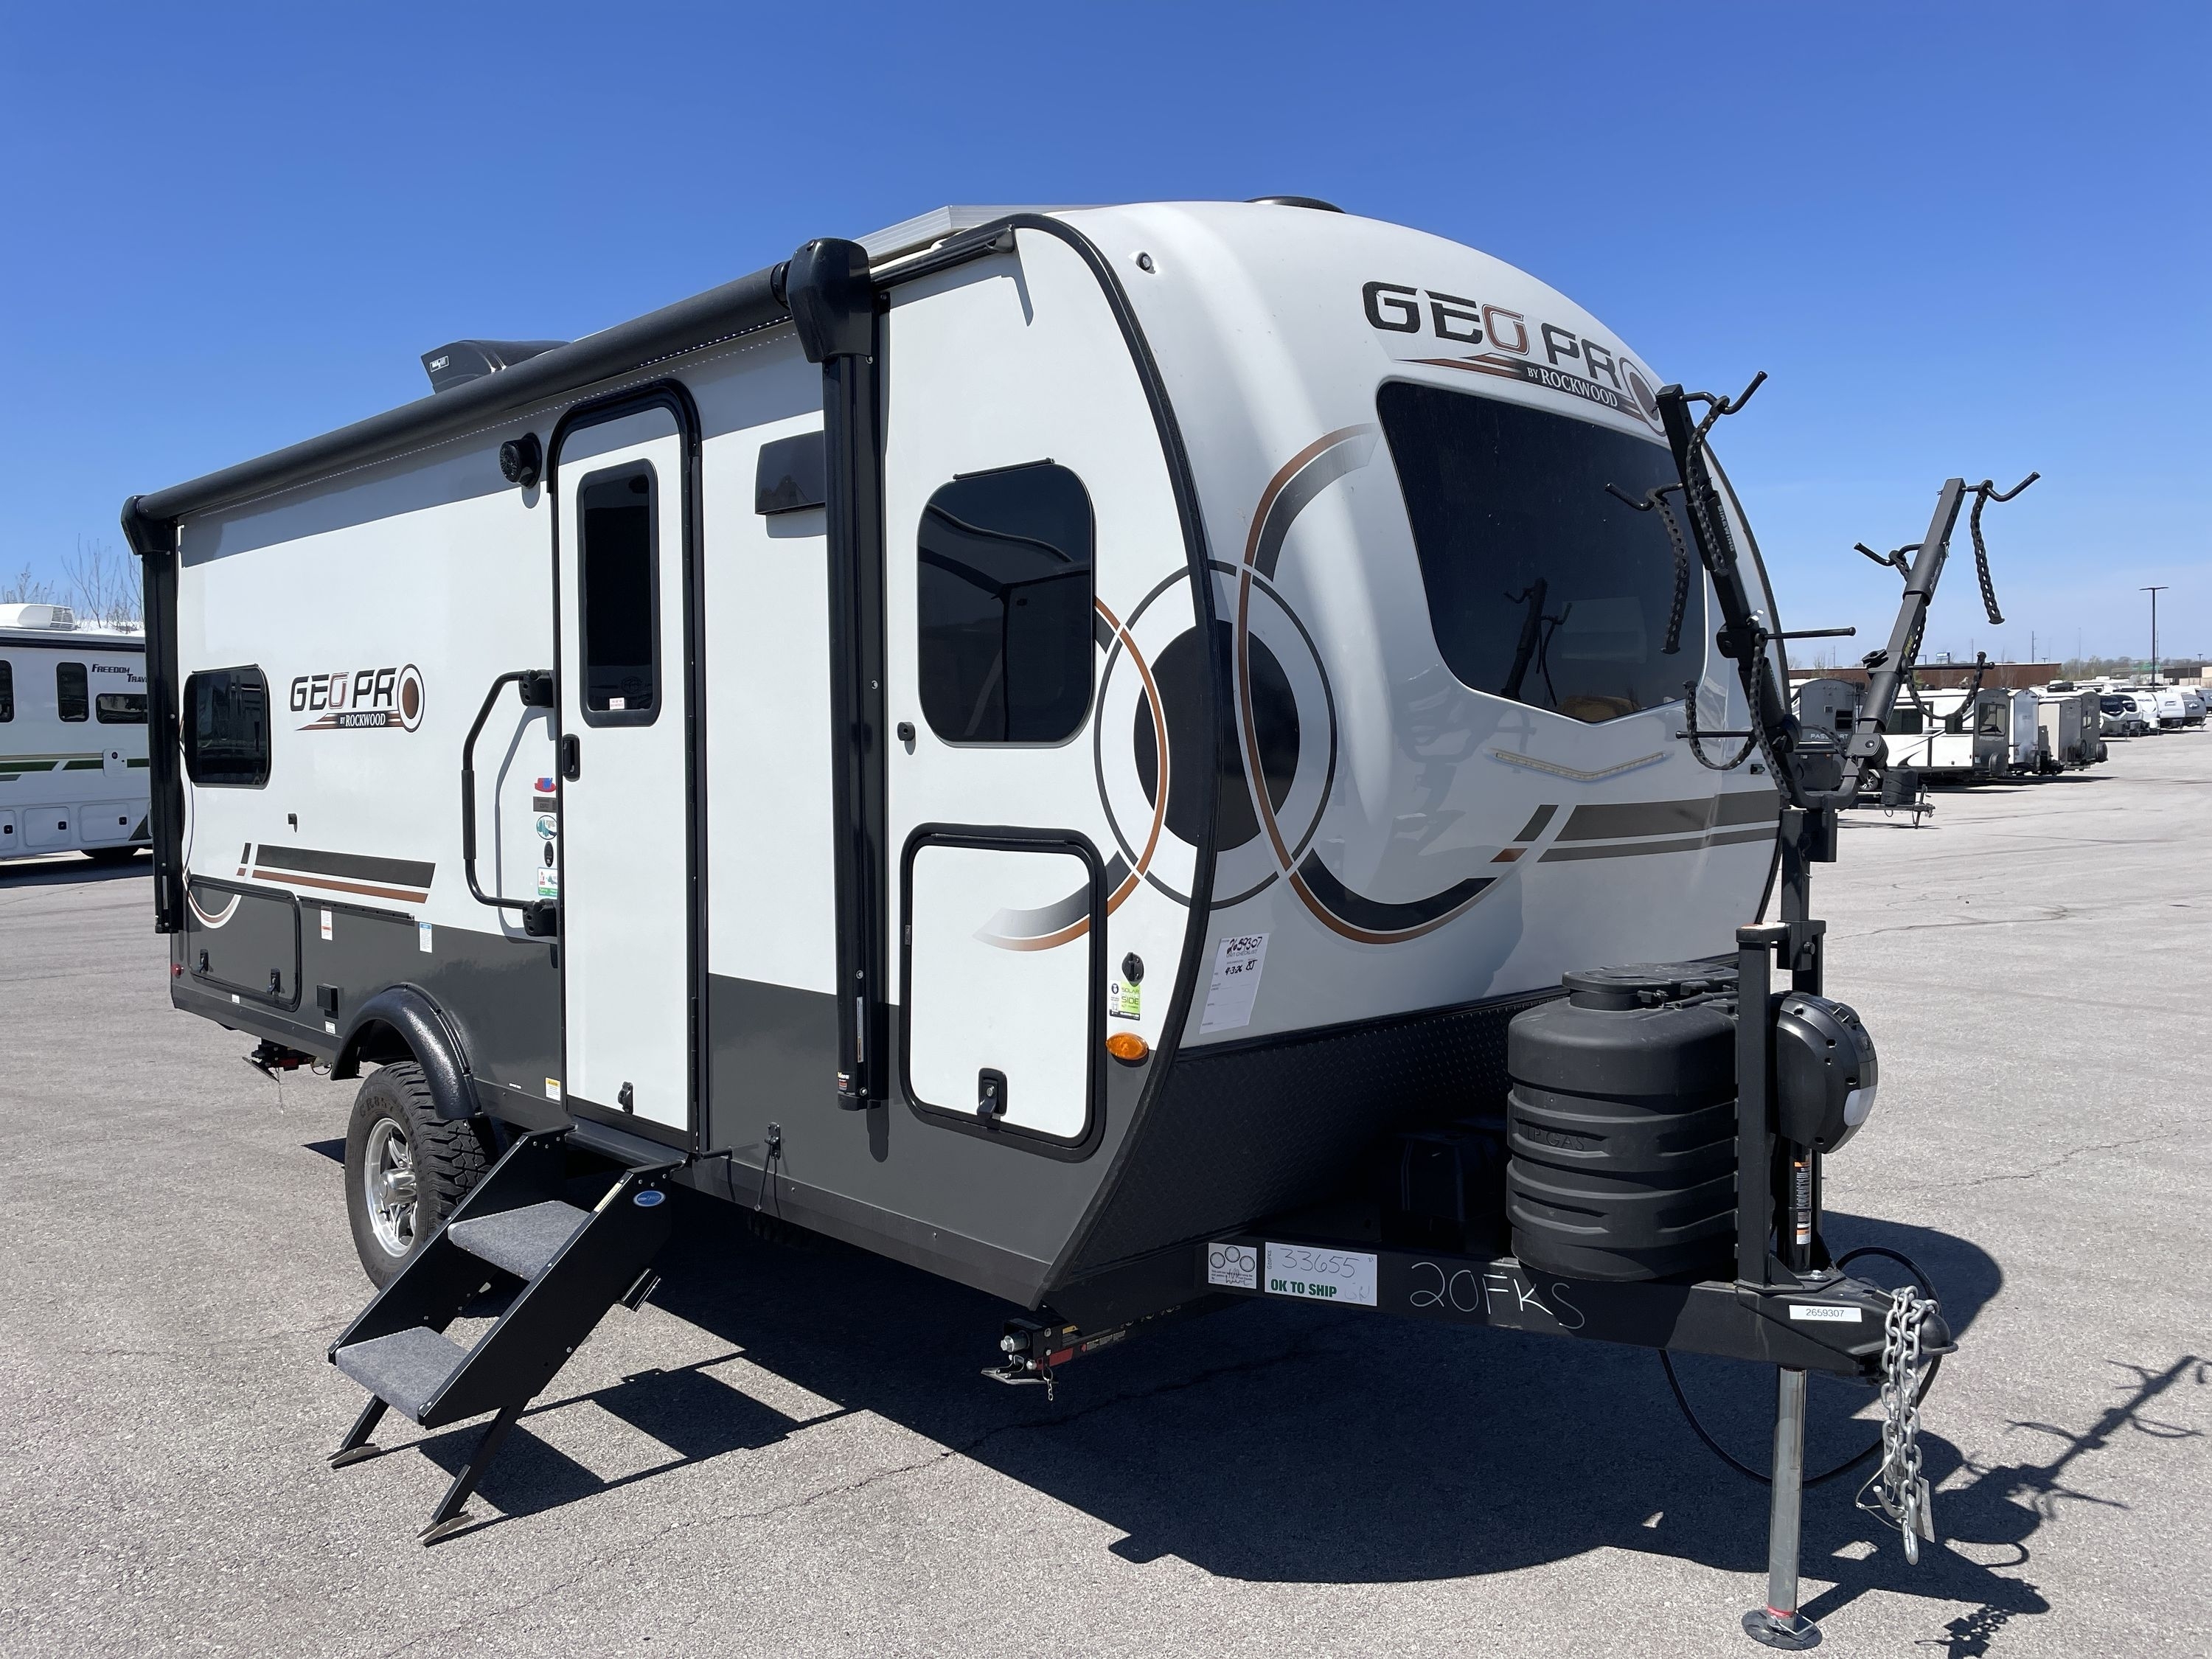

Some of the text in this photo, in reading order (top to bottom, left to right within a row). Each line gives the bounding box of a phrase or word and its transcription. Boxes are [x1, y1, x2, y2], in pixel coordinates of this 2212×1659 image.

[1363, 281, 1530, 355] GEO
[1527, 366, 1618, 408] BY ROCKWOOD
[91, 664, 131, 673] FREEDOM
[290, 672, 350, 712] GEO
[345, 713, 386, 727] ROCKWOOD
[1121, 996, 1139, 1005] SIDE
[1545, 1132, 1585, 1150] GAS
[1280, 1248, 1360, 1279] 33655
[1270, 1279, 1287, 1293] OK
[1290, 1281, 1305, 1294] TO
[1309, 1284, 1338, 1298] SHIP
[1410, 1262, 1585, 1329] 20FKS
[1806, 1308, 1844, 1318] 2659307
